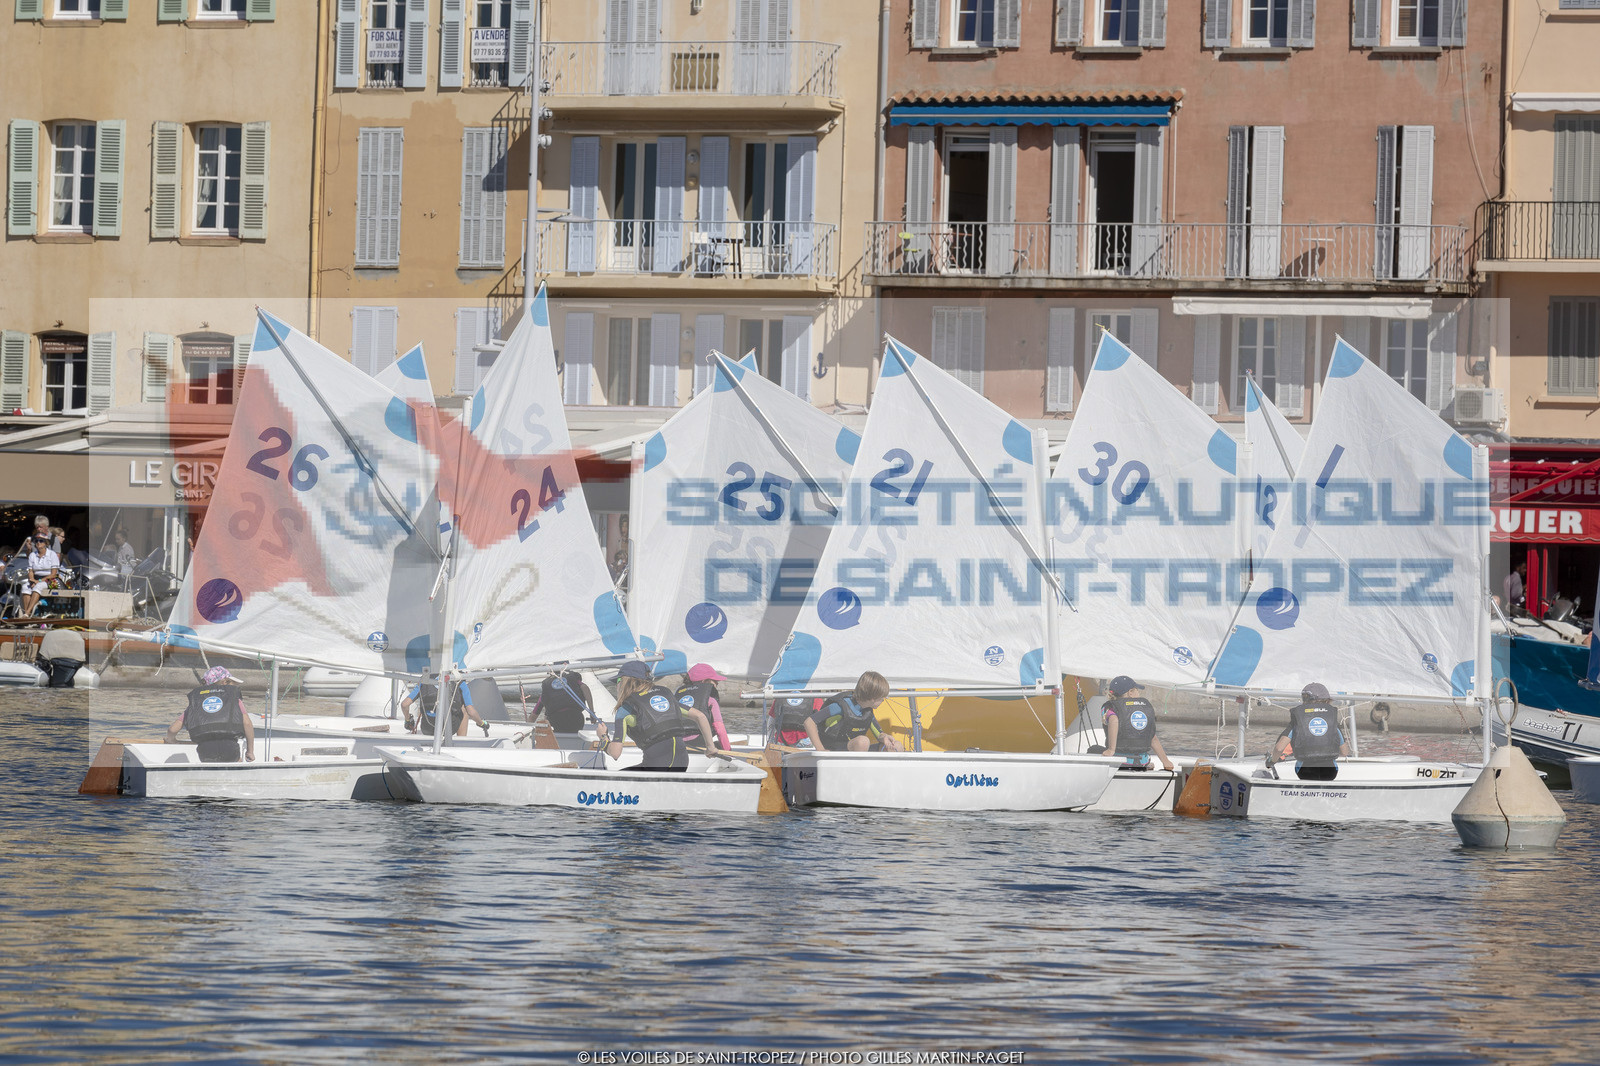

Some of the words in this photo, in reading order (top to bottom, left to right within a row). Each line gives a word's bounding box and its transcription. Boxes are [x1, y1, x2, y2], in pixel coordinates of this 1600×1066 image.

[371, 31, 385, 41] FOR
[386, 31, 404, 41] SALE
[474, 30, 480, 40] A
[481, 30, 509, 40] VENDRE
[369, 50, 376, 58] 07
[377, 50, 383, 58] 77
[383, 50, 390, 58] 93
[391, 50, 397, 58] 35
[473, 48, 480, 56] 07
[481, 48, 487, 56] 77
[488, 48, 494, 56] 93
[495, 48, 501, 56] 35
[246, 427, 330, 491] 26
[129, 460, 162, 485] LE
[870, 448, 934, 506] 21
[1078, 442, 1150, 505] 30
[718, 462, 792, 521] 25
[511, 465, 567, 543] 24
[1416, 767, 1457, 779] HOWZIT
[1300, 791, 1348, 799] SAINT-TROPEZ
